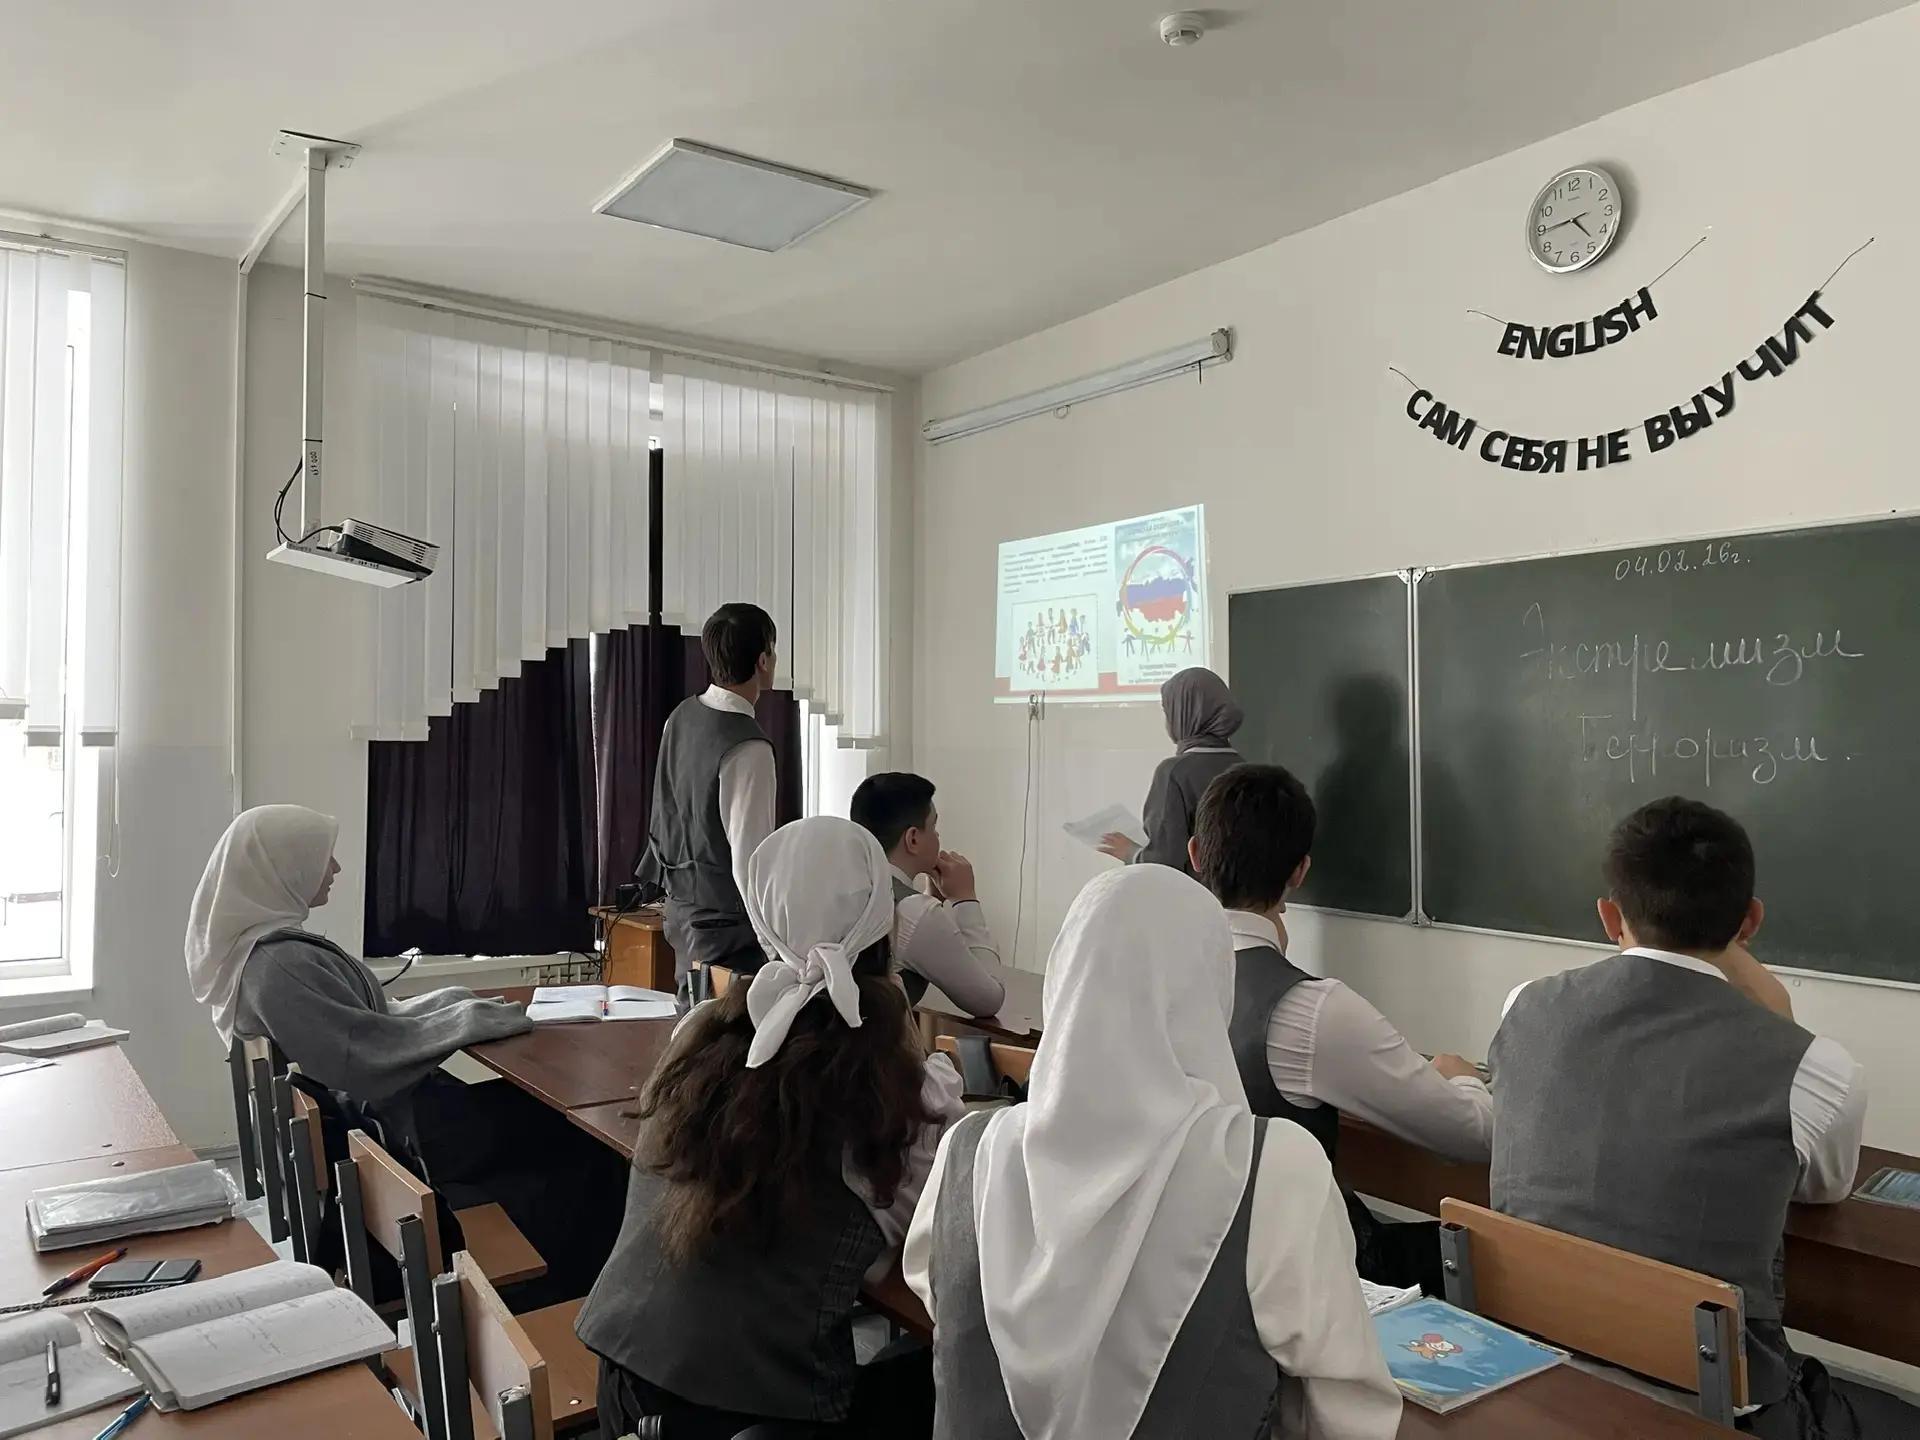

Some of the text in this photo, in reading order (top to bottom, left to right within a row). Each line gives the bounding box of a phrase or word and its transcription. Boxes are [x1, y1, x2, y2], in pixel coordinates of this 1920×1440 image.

[1568, 178, 1580, 192] 12
[1553, 188, 1562, 201] 11
[1598, 188, 1608, 201] 2
[1541, 205, 1553, 218] 10
[1604, 204, 1613, 216] 3
[1537, 224, 1546, 236] 9
[1599, 223, 1608, 234] 4
[1543, 241, 1552, 253] 8
[1587, 241, 1596, 254] 5
[1554, 250, 1563, 263] 7
[1570, 251, 1580, 263] 6
[1497, 287, 1658, 360] ENGLISH
[1407, 390, 1475, 451] САМ
[1480, 430, 1567, 474] СЕБЯ
[1577, 428, 1630, 472] НЕ
